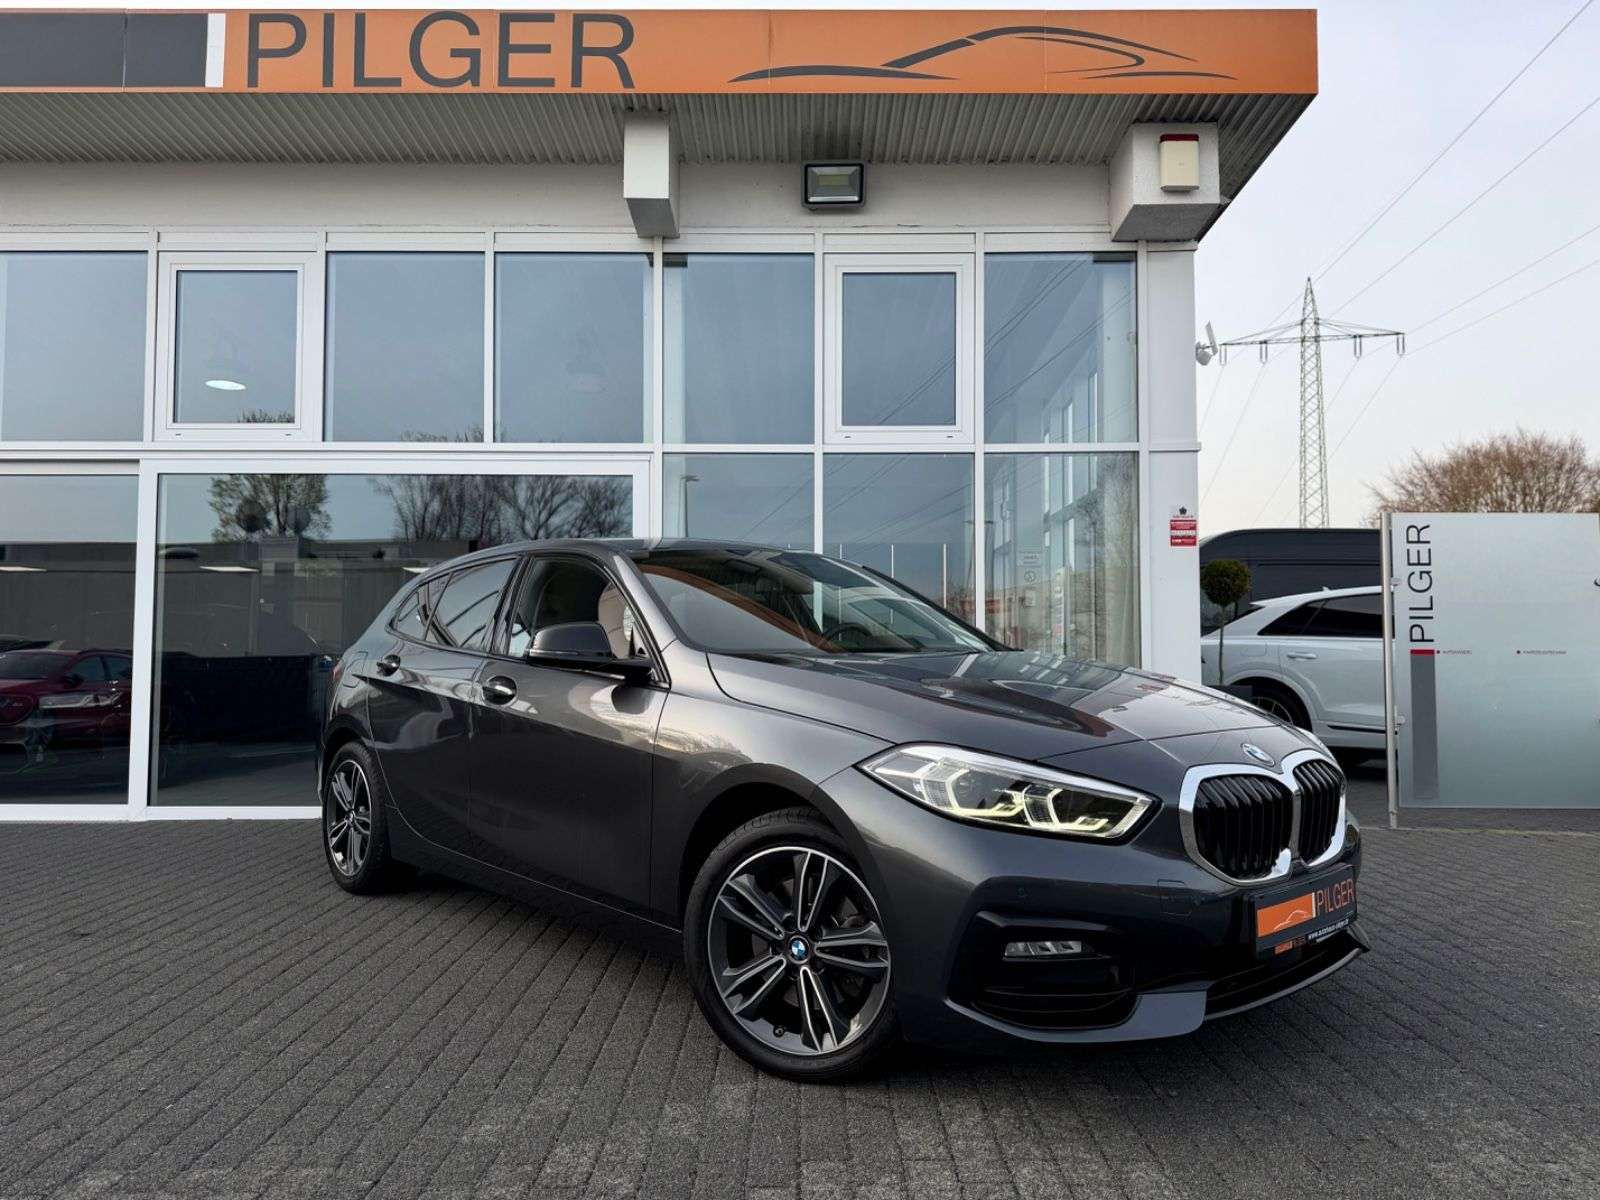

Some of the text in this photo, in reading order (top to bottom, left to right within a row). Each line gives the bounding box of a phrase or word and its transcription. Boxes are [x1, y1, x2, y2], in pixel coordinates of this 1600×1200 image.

[247, 11, 635, 89] PILGER
[1405, 524, 1435, 643] PILGER
[1316, 878, 1355, 916] PILGER
